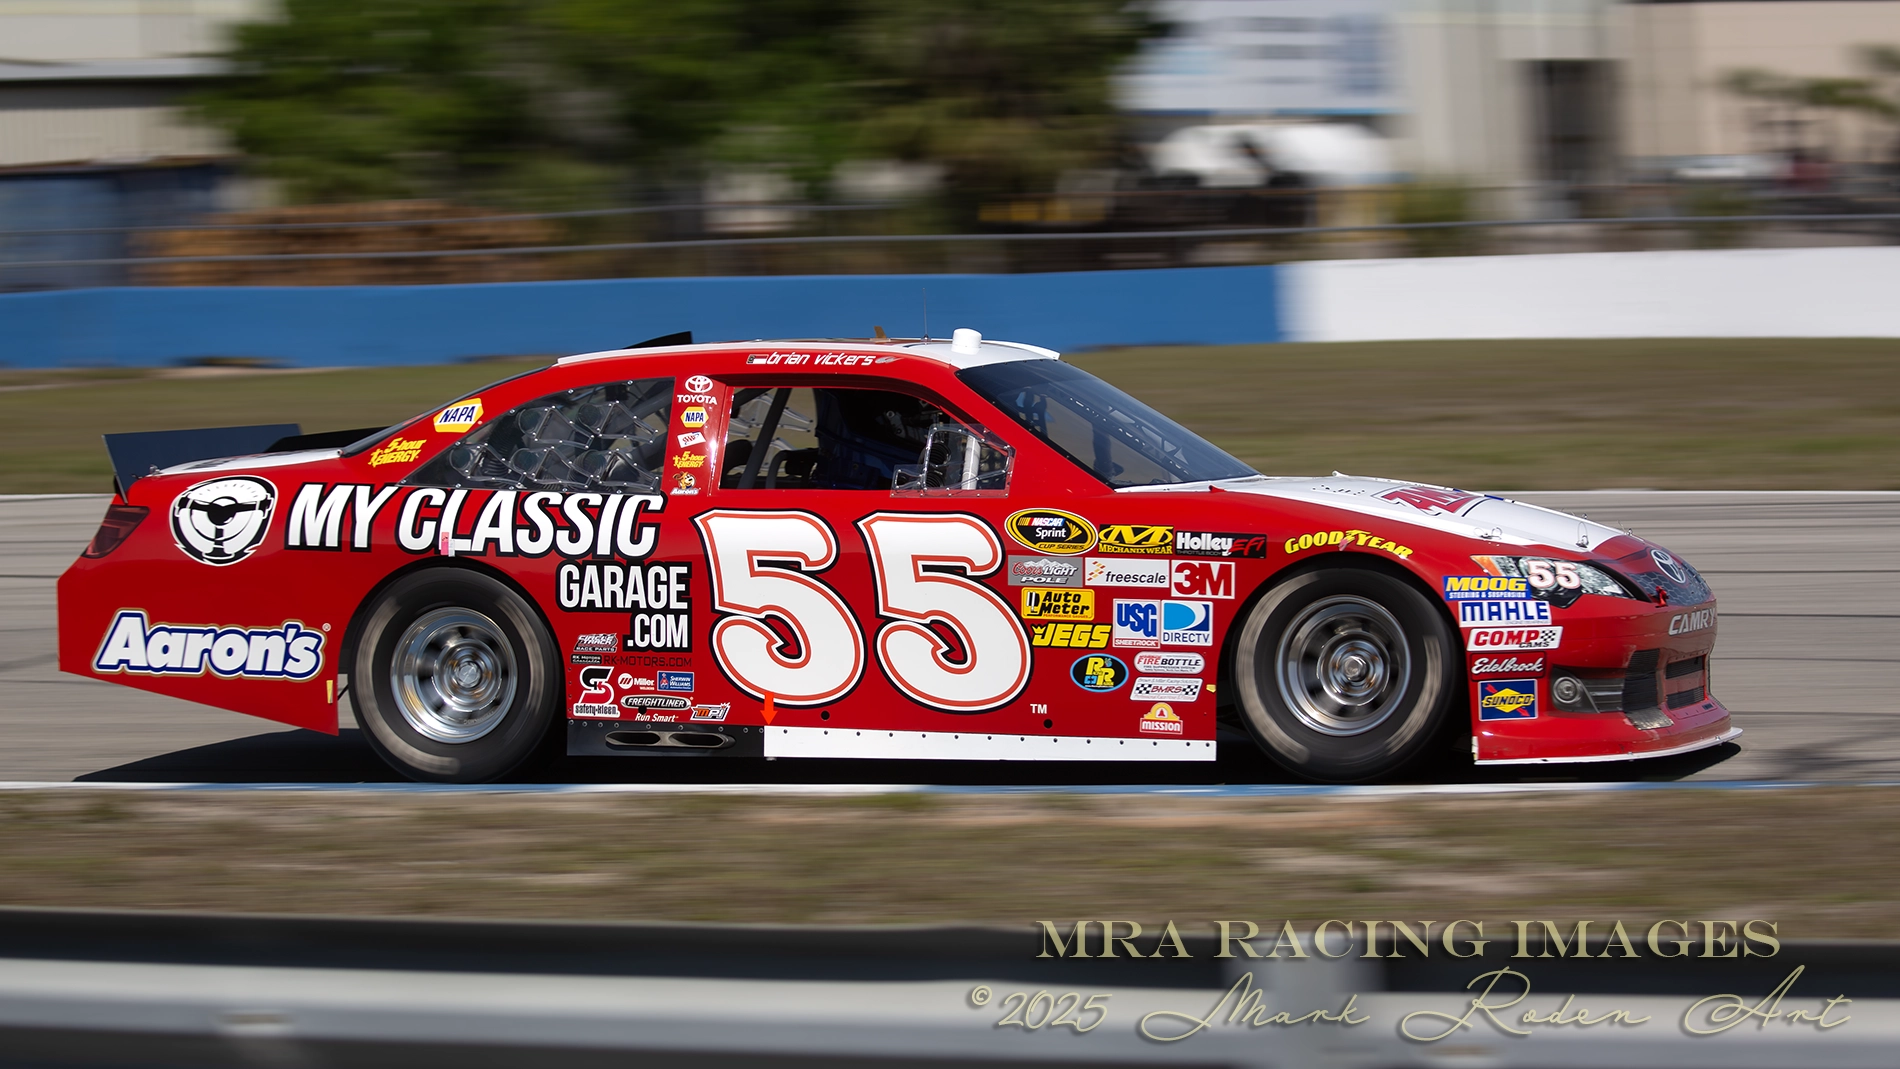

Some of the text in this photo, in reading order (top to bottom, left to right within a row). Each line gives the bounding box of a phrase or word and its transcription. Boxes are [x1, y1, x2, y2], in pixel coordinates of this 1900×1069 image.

[767, 351, 876, 366] brian vickers
[677, 394, 717, 405] TOYOTA
[439, 406, 476, 423] NAPA
[685, 412, 704, 422] NAPA
[384, 437, 427, 454] 5-hour
[377, 450, 421, 465] ENERGY
[670, 488, 699, 496] Aaron's
[288, 484, 664, 557] MY CLASSIC
[1031, 517, 1064, 526] NASCAR
[1035, 527, 1066, 539] Sprint
[1177, 532, 1234, 556] Holley
[1284, 529, 1413, 559] GOODYEAR
[1012, 561, 1078, 576] Coors LIGHT
[1527, 560, 1581, 589] 55
[1105, 571, 1167, 583] freescale
[1173, 562, 1233, 597] 3M
[1446, 577, 1527, 592] MOOG
[559, 564, 688, 610] GARAGE
[1043, 591, 1081, 603] Auto
[693, 509, 1033, 712] 55
[1041, 603, 1090, 615] Meter
[1461, 601, 1549, 621] MAHLE
[1117, 603, 1157, 637] USG
[1668, 607, 1716, 636] CAMRY
[627, 614, 688, 649] .COM
[1032, 622, 1112, 649] JEGS
[1163, 632, 1210, 643] DIRECTV
[1474, 630, 1540, 646] COMP
[97, 615, 320, 675] Aaron's
[1518, 641, 1550, 649] CAMS
[604, 655, 692, 667] RK-MOTORS.COM
[1137, 657, 1201, 667] FIRE BOTTLE
[1471, 657, 1543, 674] Edelbrock
[634, 677, 655, 686] Miller
[1151, 685, 1182, 693] BMRS
[627, 697, 685, 708] FREIGHTLINER
[1484, 695, 1531, 706] SUNOCO
[1030, 704, 1048, 714] TM
[635, 713, 676, 722] Run Smart
